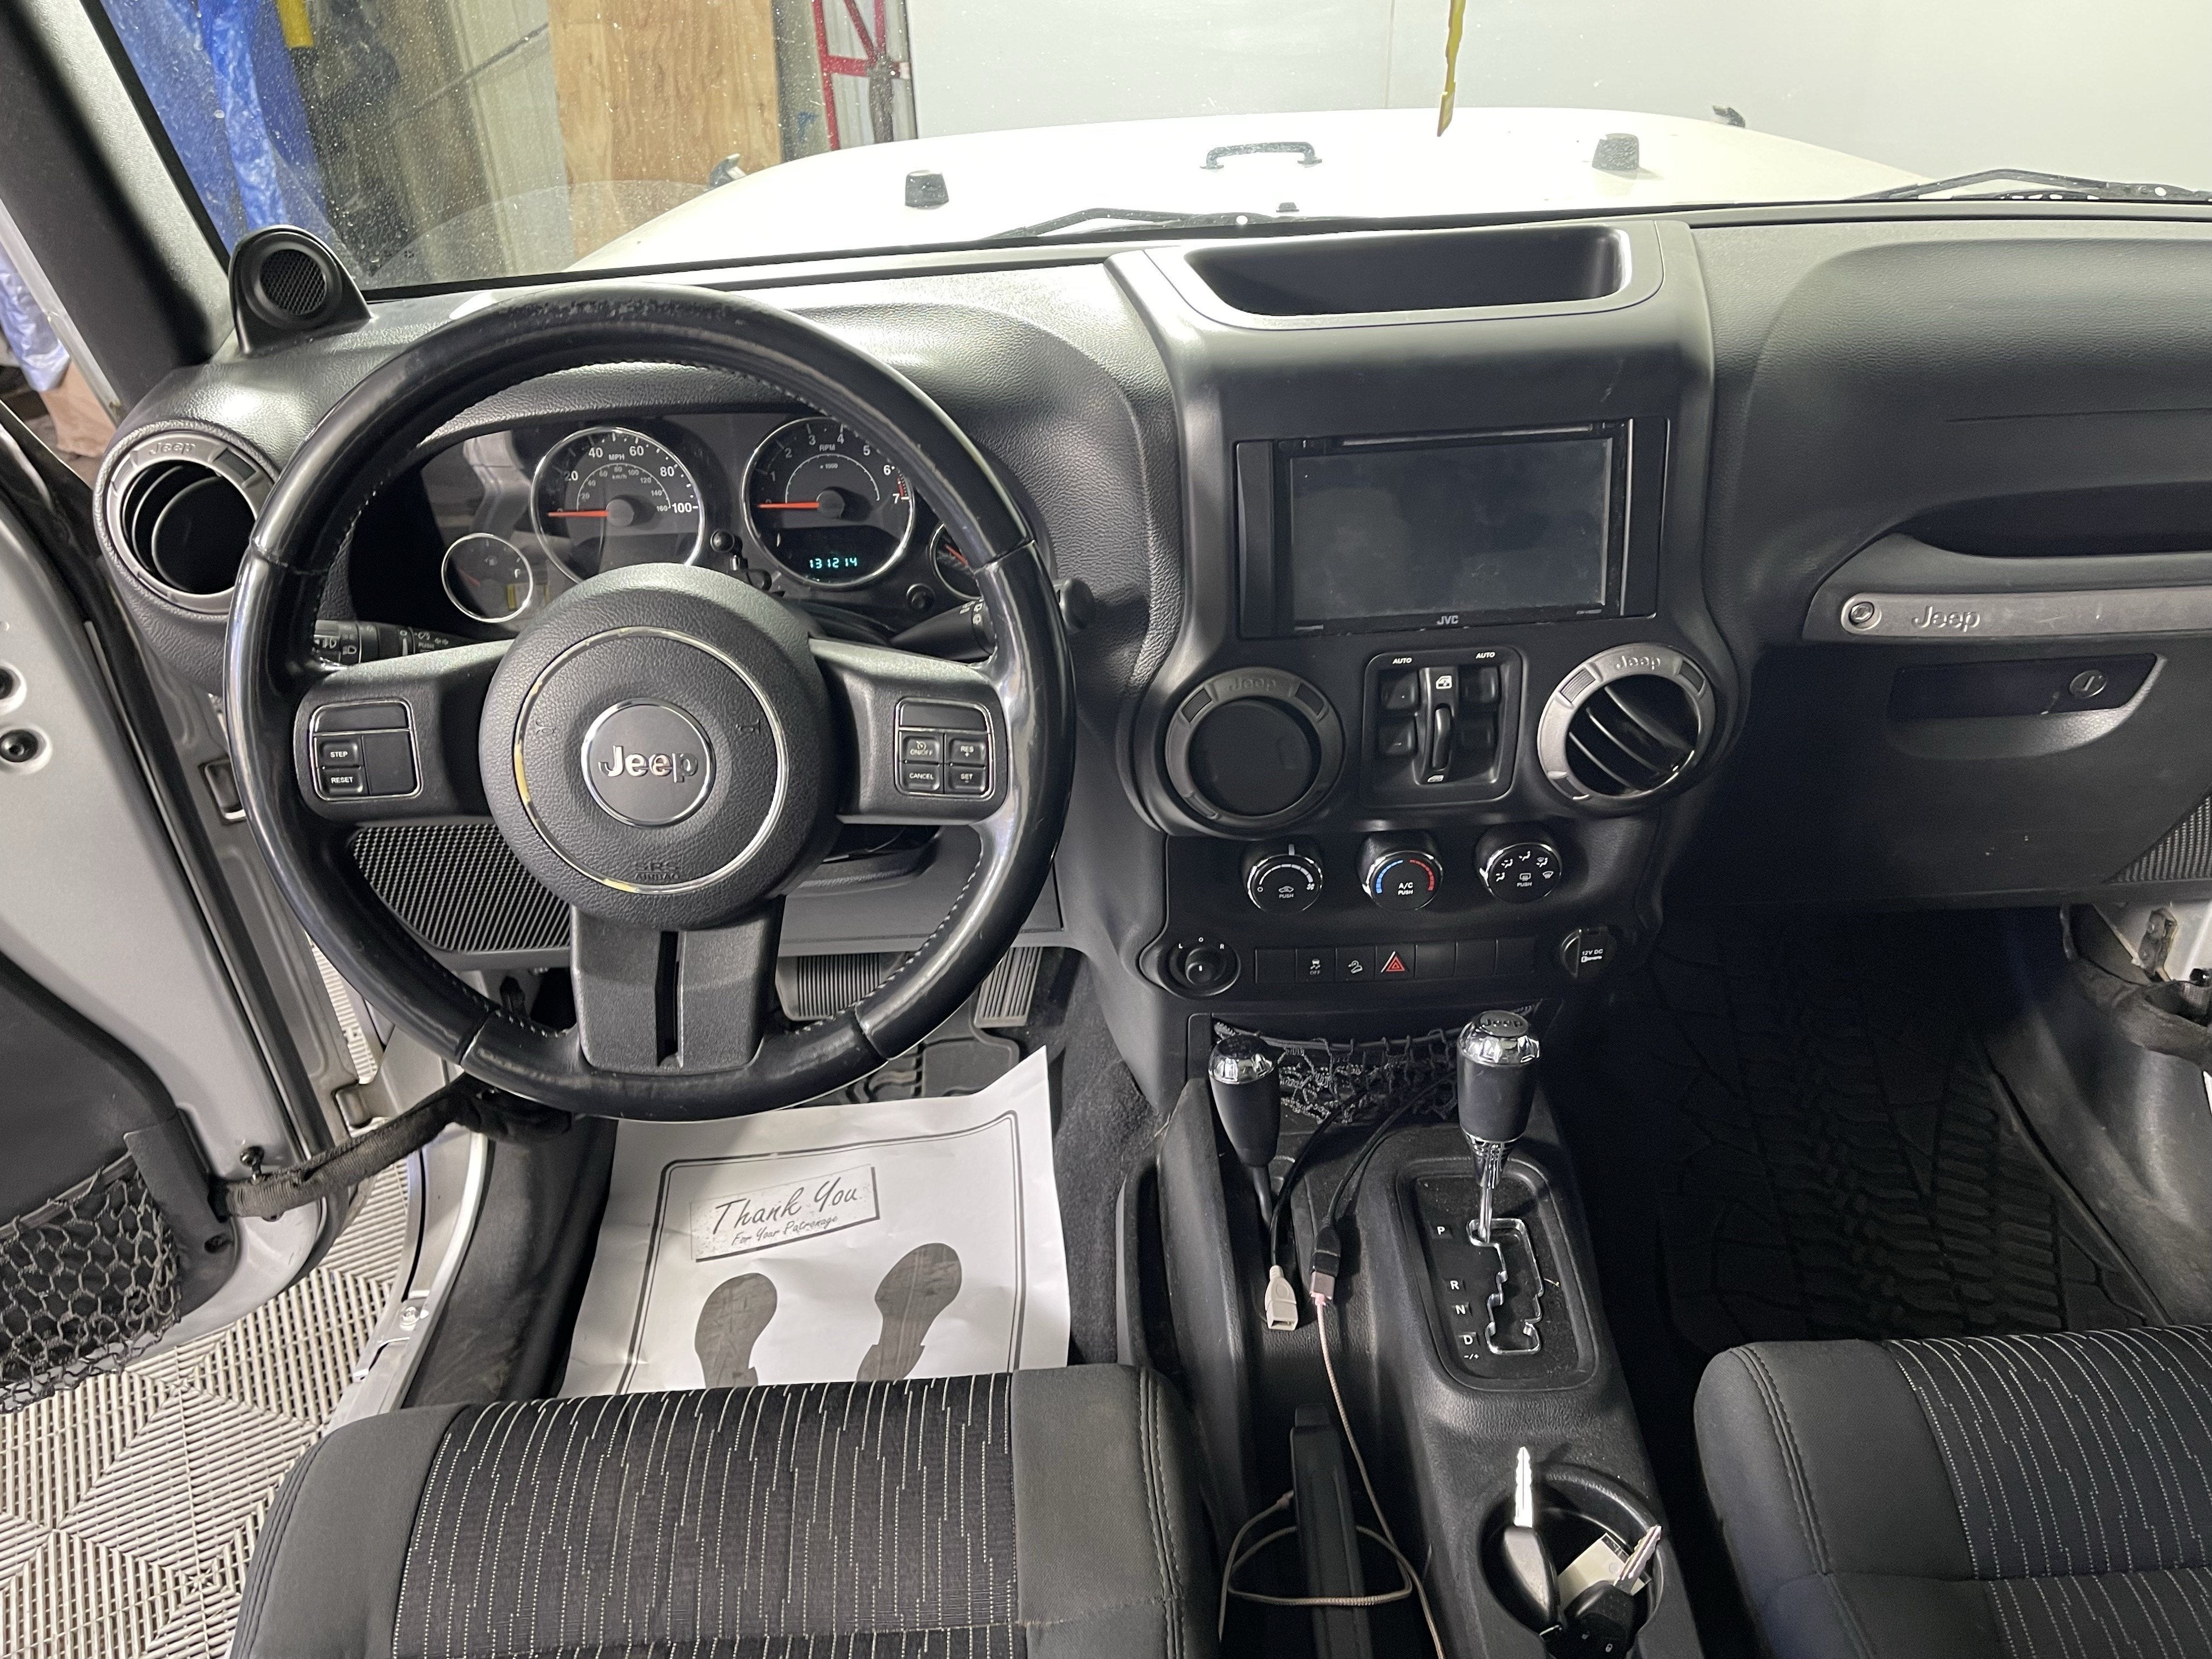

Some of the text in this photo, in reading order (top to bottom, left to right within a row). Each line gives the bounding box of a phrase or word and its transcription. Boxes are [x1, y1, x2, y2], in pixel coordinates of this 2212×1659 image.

[809, 435, 816, 445] 3
[837, 433, 844, 444] 4
[149, 442, 195, 455] Jeep
[589, 447, 603, 458] 40
[629, 445, 644, 456] 60
[785, 448, 792, 458] 2
[863, 444, 871, 456] 5
[565, 470, 578, 481] 20
[660, 466, 674, 477] 80
[770, 470, 776, 481] 1
[883, 465, 891, 476] 6
[892, 493, 900, 504] 7
[672, 503, 692, 513] 100
[809, 557, 857, 569] 131214
[1436, 615, 1459, 625] JVC
[1911, 606, 1981, 633] Jeep
[598, 745, 698, 783] Jeep
[713, 1187, 804, 1235] Thank
[731, 1216, 838, 1246] For Your Patronage
[1437, 1226, 1445, 1235] P
[1450, 1280, 1459, 1290] R
[1455, 1305, 1465, 1314] N
[1463, 1335, 1473, 1345] D
